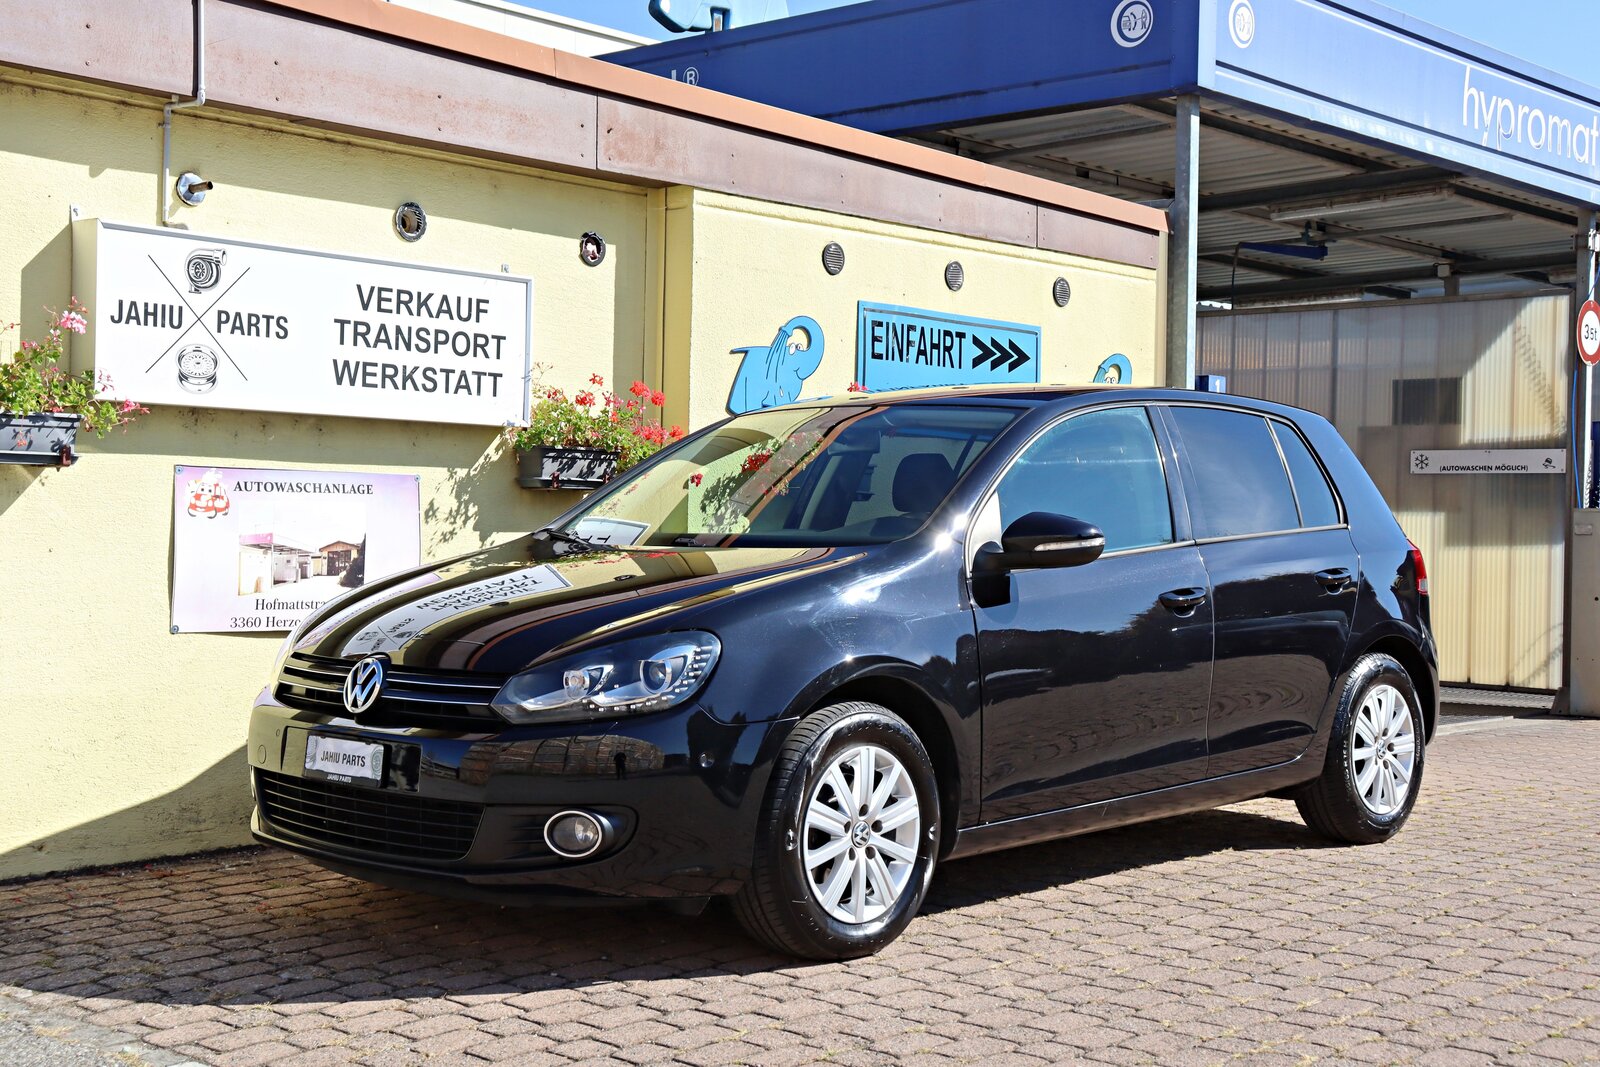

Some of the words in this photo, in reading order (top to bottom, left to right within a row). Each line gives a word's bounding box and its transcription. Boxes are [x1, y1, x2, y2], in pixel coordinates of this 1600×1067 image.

[1462, 64, 1599, 166] hypromat
[110, 299, 184, 330] JAHIU
[216, 309, 289, 340] PARTS
[356, 284, 490, 324] VERKAUF
[333, 318, 507, 360] TRANSPORT
[870, 320, 967, 370] EINFAHRT
[332, 358, 504, 397] WERKSTATT
[233, 480, 375, 495] AUTOWASCHANLAGE
[229, 616, 262, 628] 3360
[320, 750, 341, 764] JAHIU
[341, 753, 366, 768] PARTS
